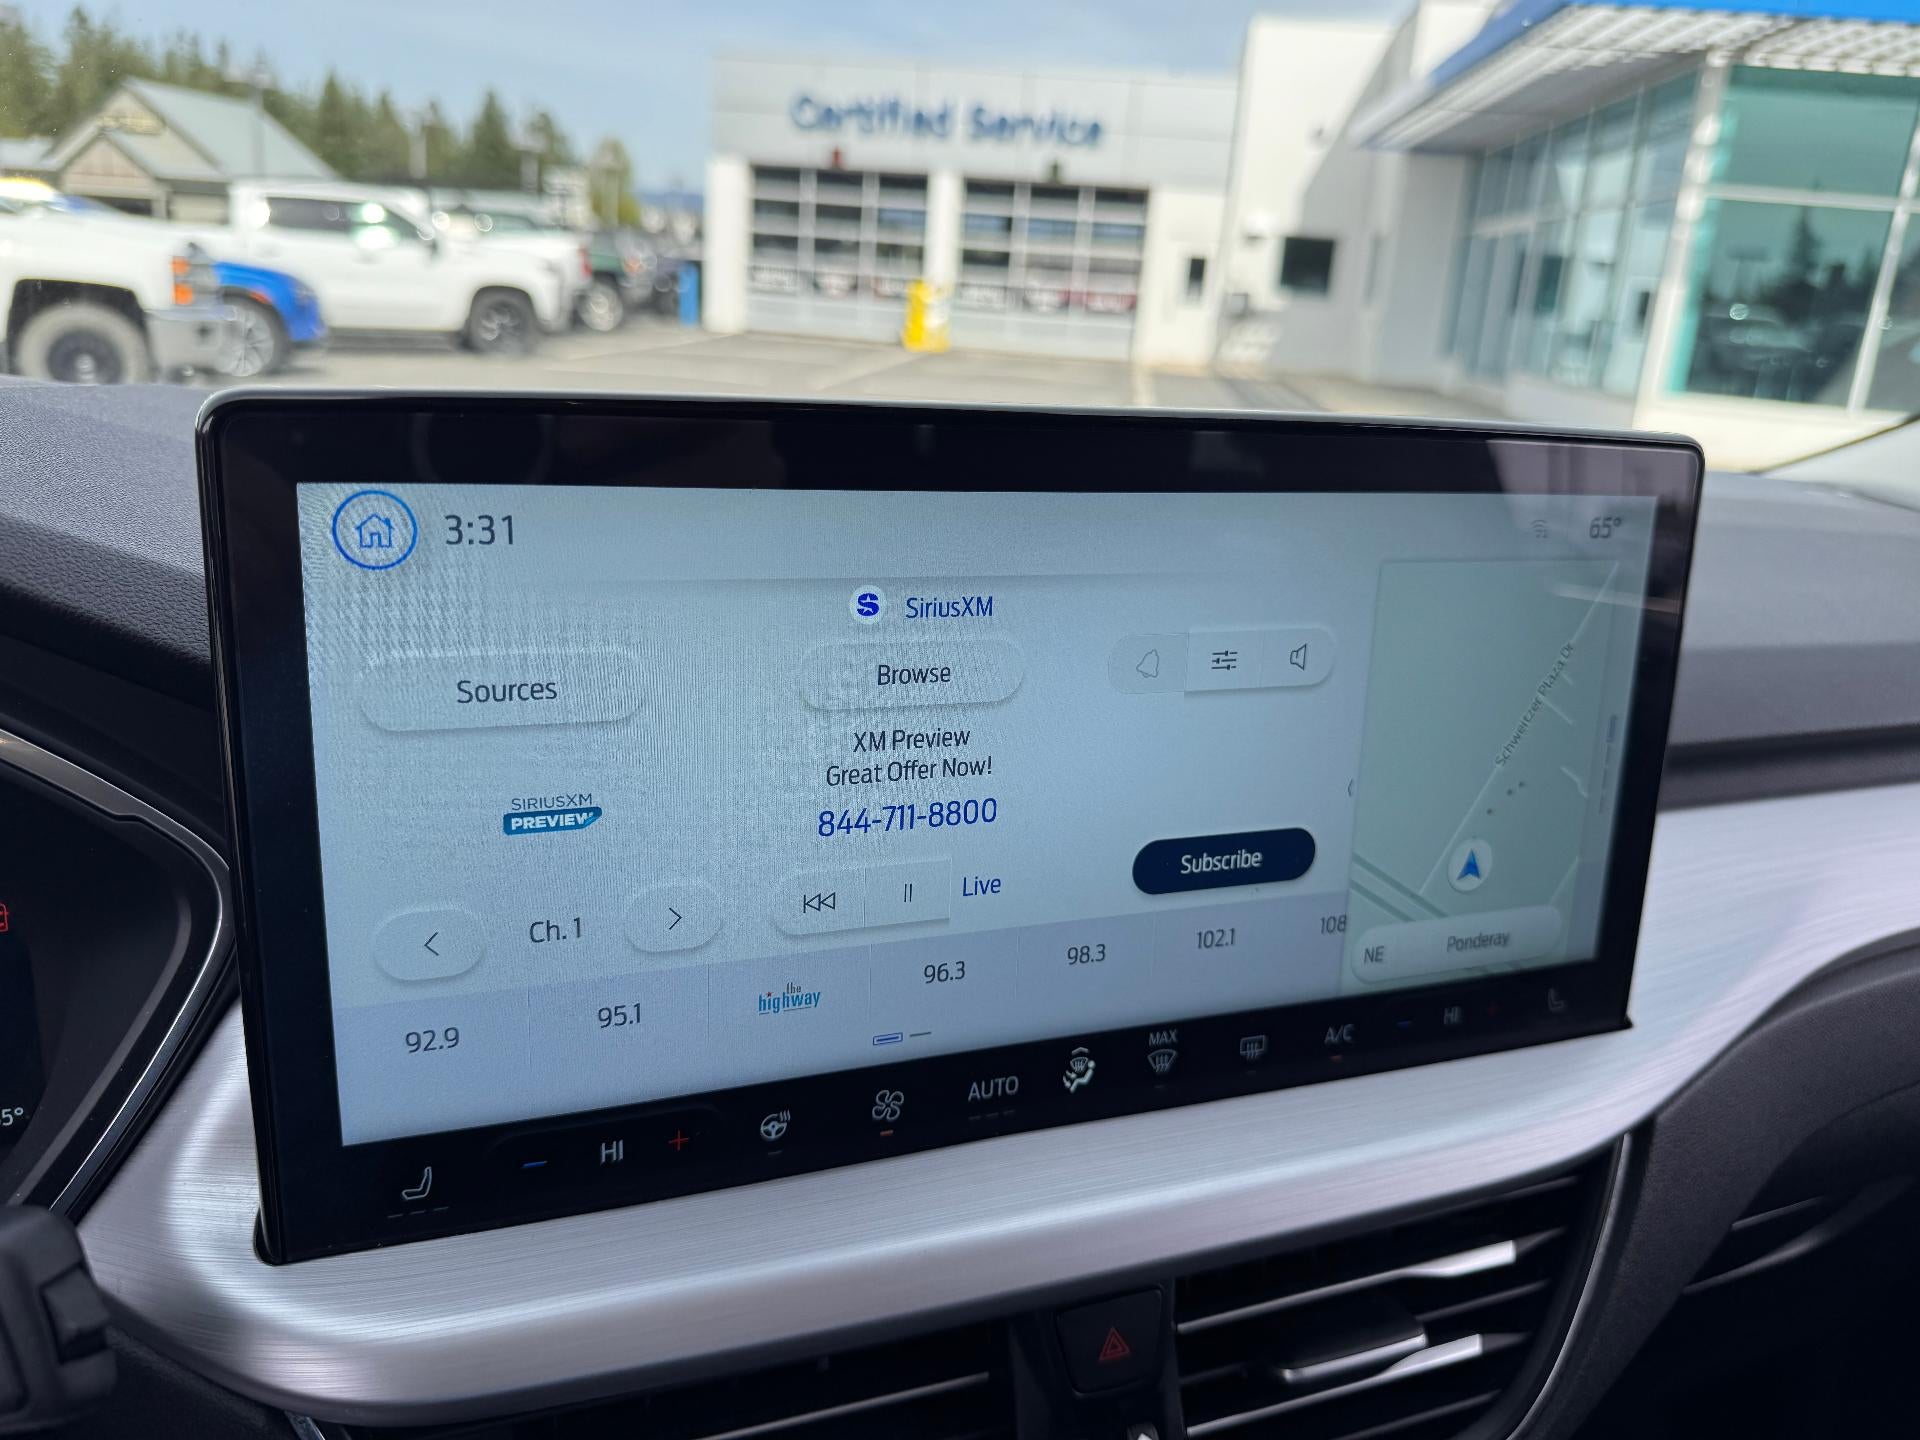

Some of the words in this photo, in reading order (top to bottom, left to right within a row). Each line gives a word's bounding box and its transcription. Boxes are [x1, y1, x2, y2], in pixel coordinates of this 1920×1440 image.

[789, 95, 951, 138] Certified
[969, 104, 1106, 146] Service
[444, 515, 517, 546] 3:31
[905, 595, 995, 620] SiriusXM
[877, 662, 952, 687] Browse
[1537, 660, 1565, 696] Plaza
[456, 678, 559, 705] Sources
[853, 730, 887, 753] XM
[891, 727, 971, 750] Preview
[825, 763, 882, 787] Great
[887, 759, 937, 783] Offer
[942, 755, 994, 779] Now!
[511, 793, 593, 811] SIRIUSXM
[511, 811, 595, 831] PREVIEW
[818, 797, 999, 837] 844-711-8800
[1180, 849, 1263, 876] Subscribe
[962, 875, 1002, 897] Live
[529, 919, 567, 944] Ch.
[573, 917, 584, 939] 1
[1196, 927, 1236, 950] 102.1
[1446, 928, 1510, 953] Ponderay
[1066, 943, 1107, 966] 98.3
[1363, 945, 1385, 965] NE
[923, 960, 967, 984] 96.3
[786, 982, 802, 995] the
[598, 1003, 643, 1029] 95.1
[758, 991, 821, 1016] highway
[1443, 1006, 1462, 1026] HI
[405, 1026, 460, 1053] 92.9
[1148, 1028, 1179, 1047] MAX
[1324, 1023, 1355, 1046] A/C
[967, 1075, 1020, 1103] AUTO
[0, 1106, 24, 1126] 5°
[600, 1138, 625, 1165] HI
